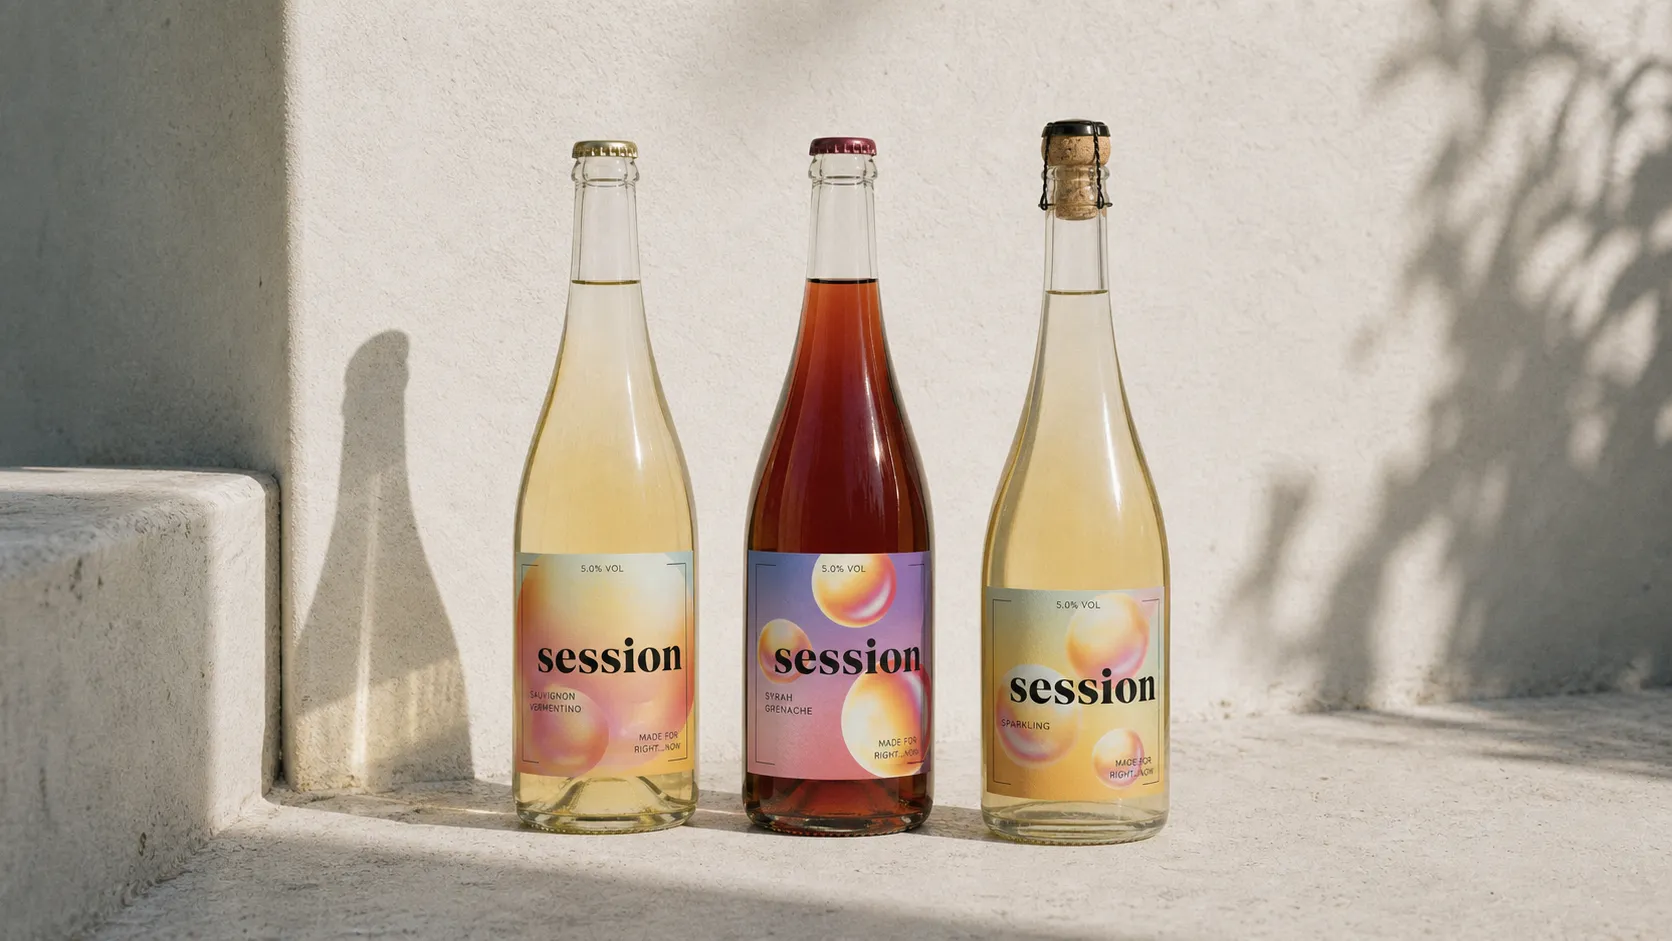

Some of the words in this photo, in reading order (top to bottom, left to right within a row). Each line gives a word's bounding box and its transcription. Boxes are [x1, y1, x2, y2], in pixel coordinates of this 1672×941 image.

[581, 564, 603, 573] 5.0%
[605, 564, 624, 573] VOL
[821, 564, 844, 573] 5.0%
[847, 564, 866, 573] VOL
[1056, 600, 1079, 609] 5.0%
[1082, 600, 1101, 609] VOL
[537, 637, 682, 674] session
[774, 638, 921, 675] session
[1010, 667, 1156, 705] session
[530, 690, 576, 700] SAUVIGNON
[765, 691, 793, 701] SYRAH
[530, 703, 582, 713] VERMENTINO
[765, 704, 813, 715] GRENACHE
[1001, 718, 1050, 730] SPARKLING
[639, 732, 662, 741] MADE
[664, 731, 679, 740] FOR
[878, 738, 901, 747] MADE
[903, 735, 917, 745] FOR
